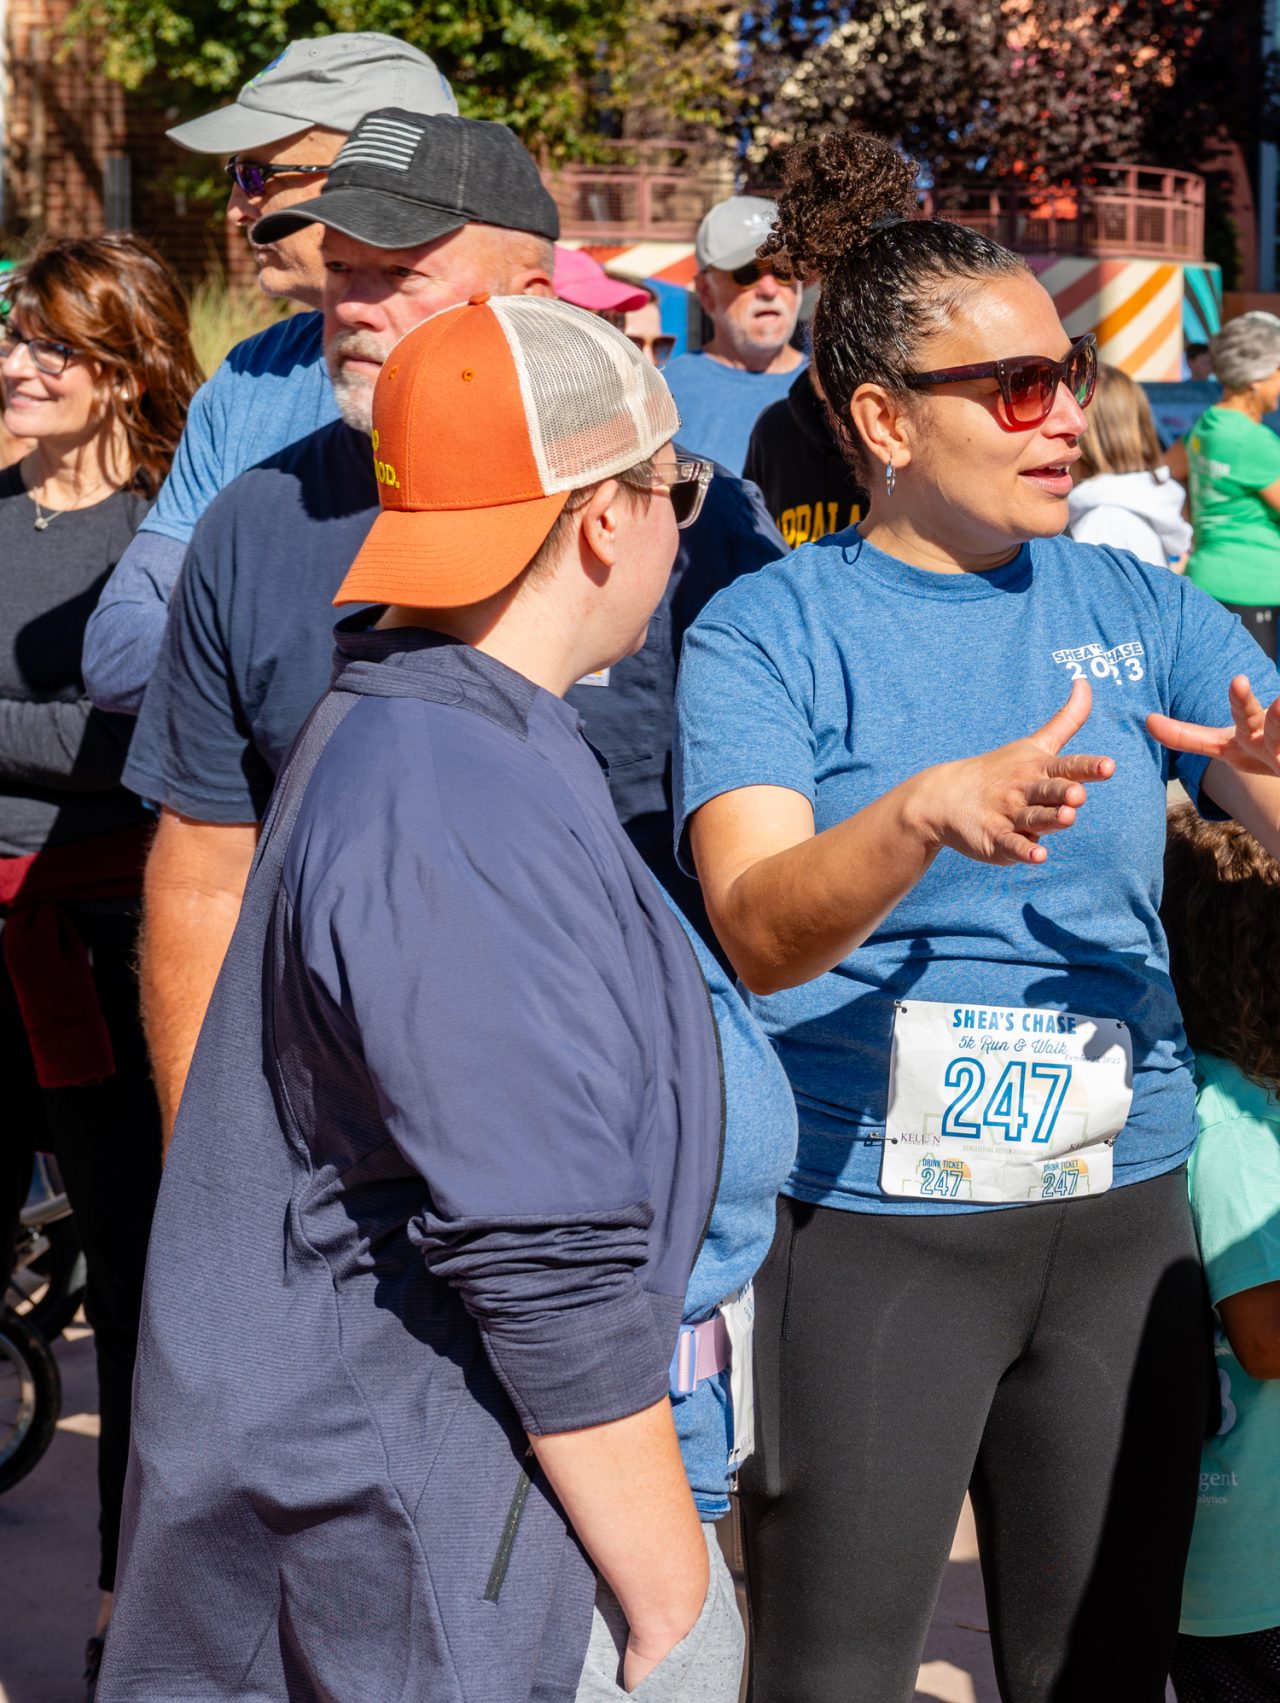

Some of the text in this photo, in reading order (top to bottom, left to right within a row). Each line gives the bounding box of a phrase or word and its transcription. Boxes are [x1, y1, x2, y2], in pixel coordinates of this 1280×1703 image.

[1105, 642, 1144, 664] HASE
[952, 1008, 1077, 1035] SHEA'S CHASE
[958, 1034, 1069, 1056] 5k Run & Walk
[941, 1056, 1073, 1144] 247
[922, 1158, 965, 1170] DRINK TICKET
[1043, 1159, 1078, 1172] DRINK TICKET
[920, 1167, 964, 1197] 247
[1041, 1169, 1080, 1199] 247
